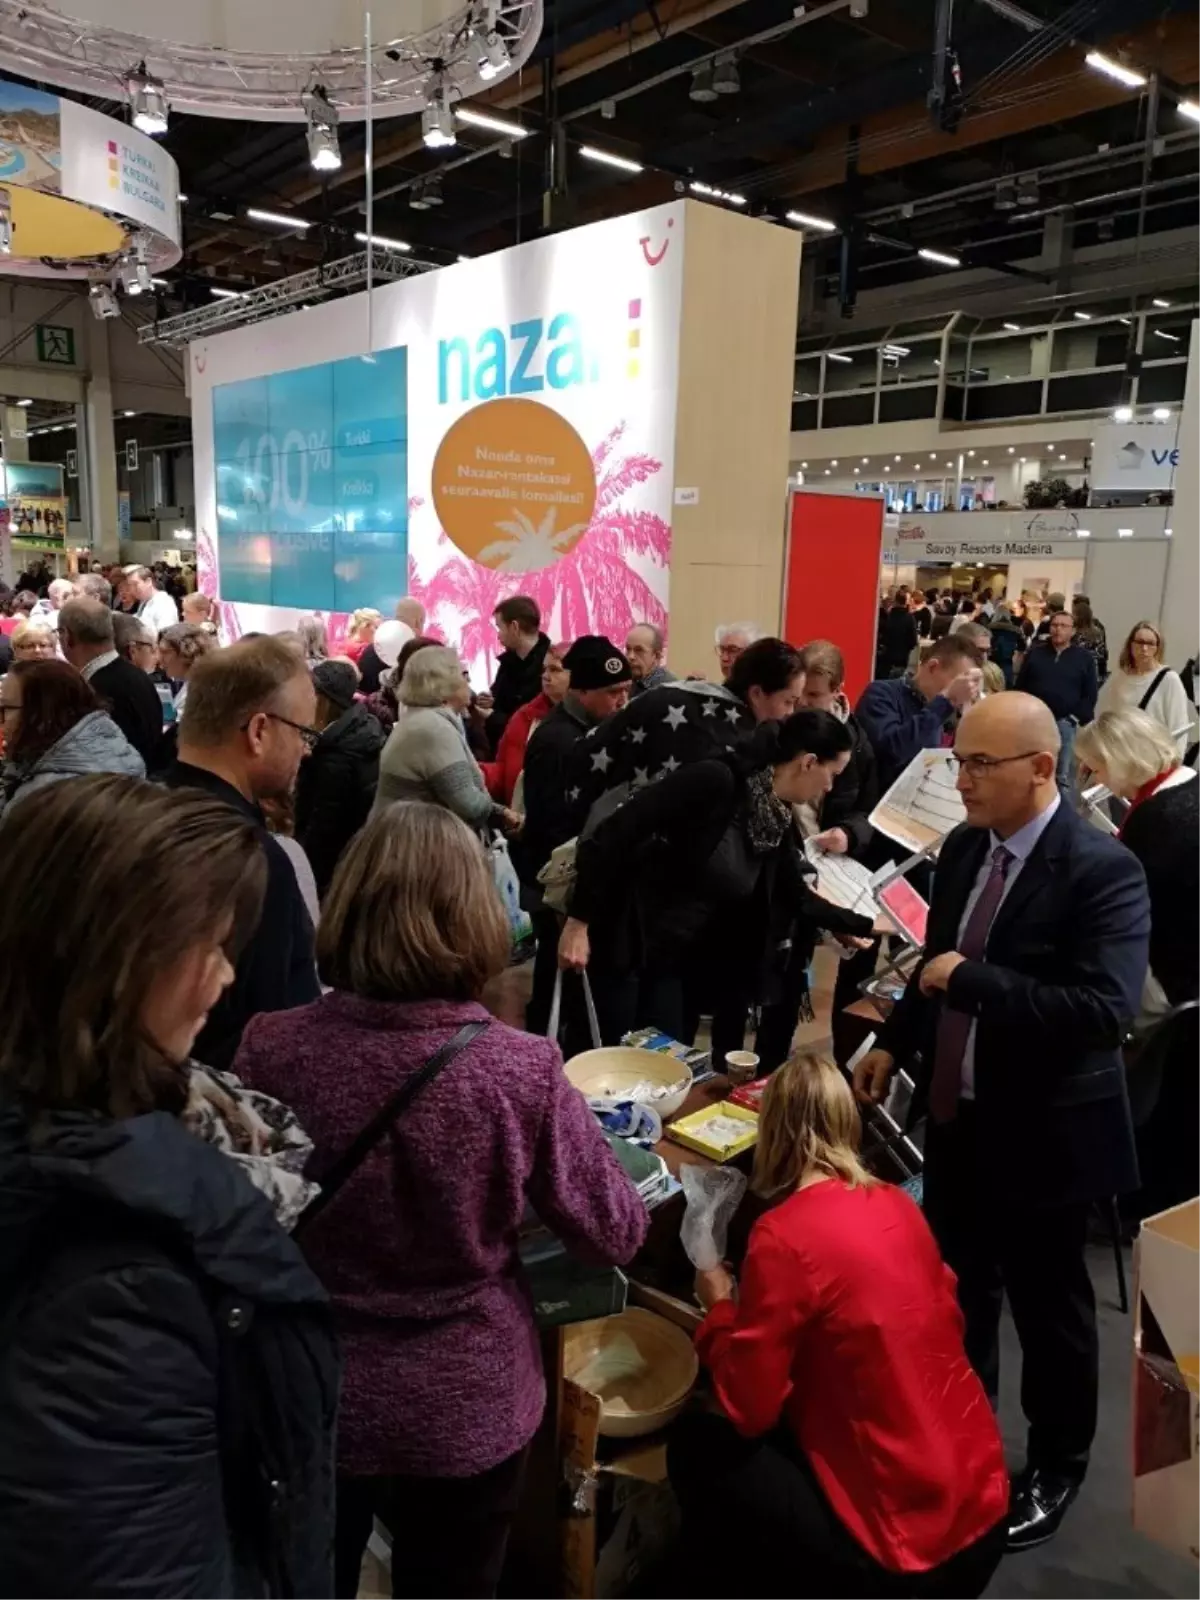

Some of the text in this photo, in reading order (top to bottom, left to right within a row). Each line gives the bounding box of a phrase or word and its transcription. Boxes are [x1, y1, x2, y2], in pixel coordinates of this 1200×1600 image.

[926, 543, 1053, 556] Savoy Resorts Madeira
